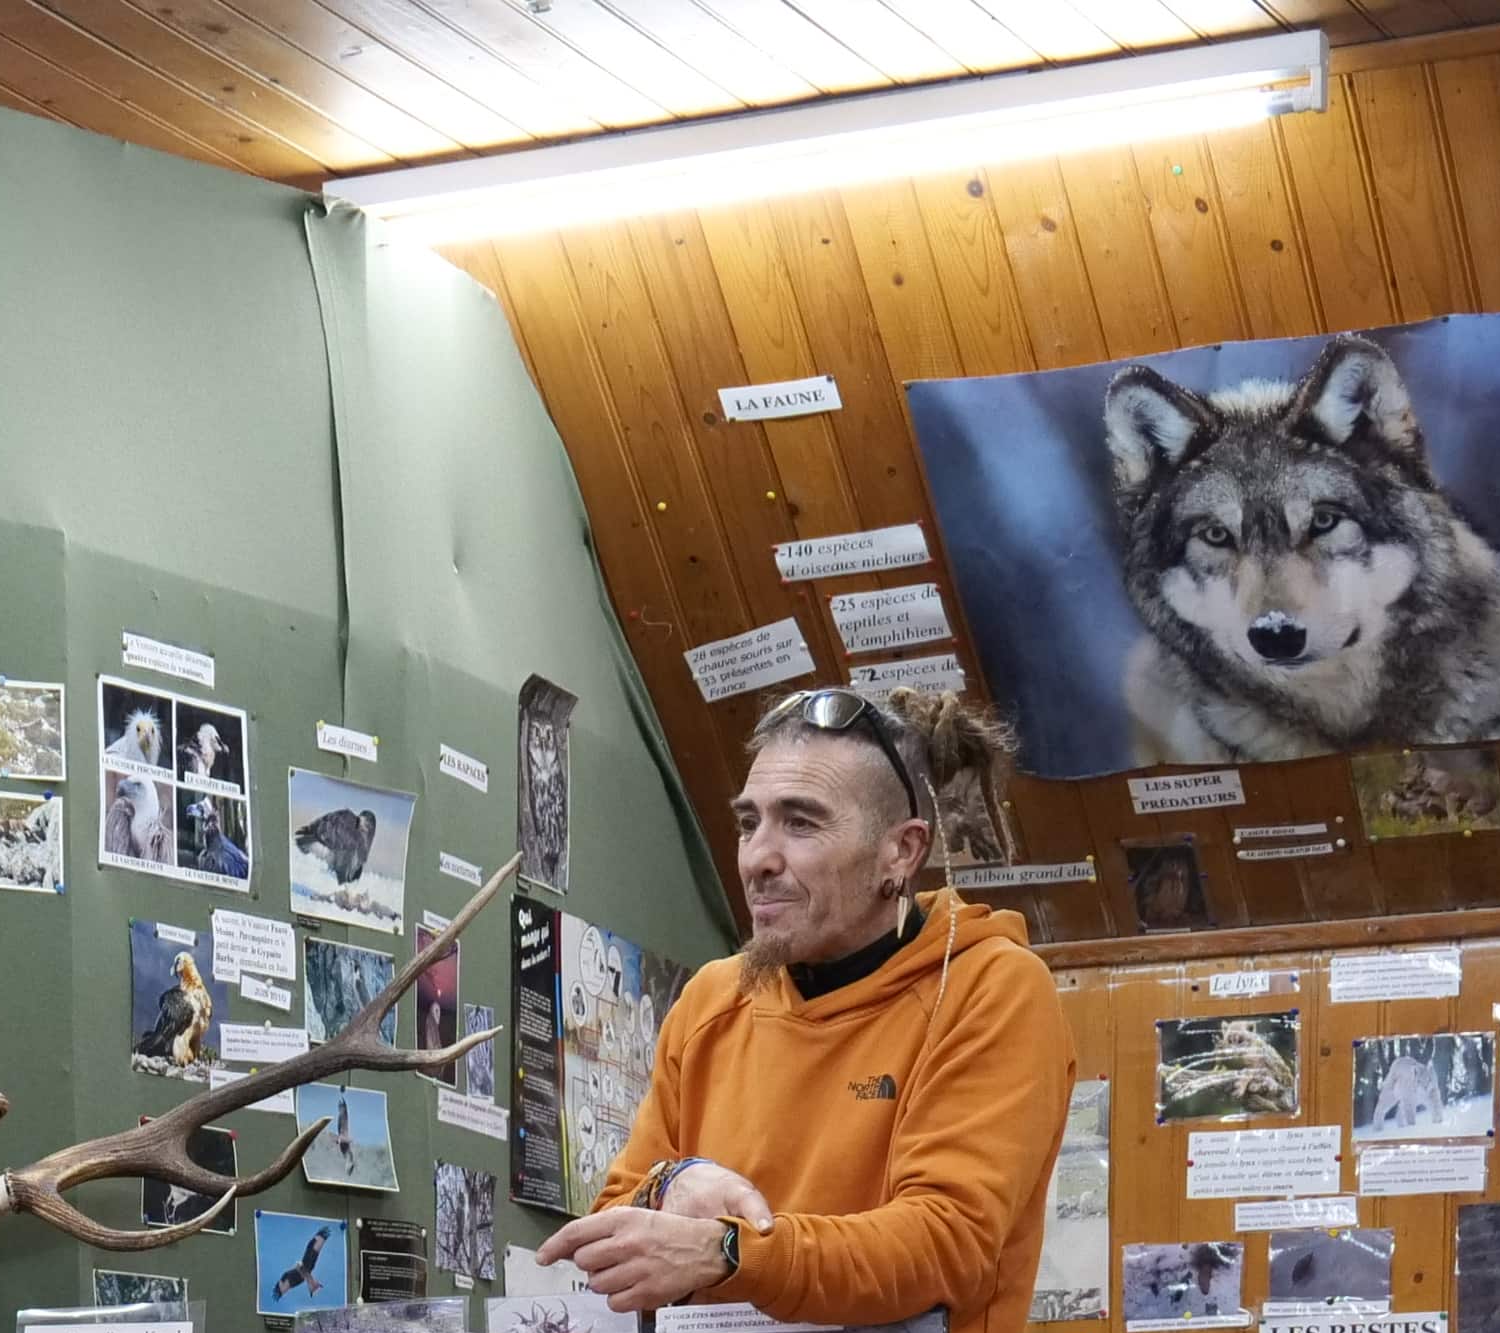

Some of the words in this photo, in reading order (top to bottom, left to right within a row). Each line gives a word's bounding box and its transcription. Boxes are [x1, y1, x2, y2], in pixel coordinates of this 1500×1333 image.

[735, 398, 757, 412] LA
[763, 389, 825, 409] FAUNE
[817, 537, 874, 555] espèces
[785, 559, 857, 579] d'oiseaux
[862, 550, 925, 567] nicheurs
[860, 589, 916, 608] espèces
[840, 613, 891, 632] reptiles
[897, 611, 910, 624] et
[845, 623, 945, 649] d'amphibiens
[1144, 779, 1170, 792] LES
[1174, 774, 1222, 790] SUPER
[1140, 789, 1237, 811] PRÉDATEURS
[974, 867, 1015, 884] hibou
[1019, 865, 1064, 884] grand
[1067, 863, 1094, 880] duc
